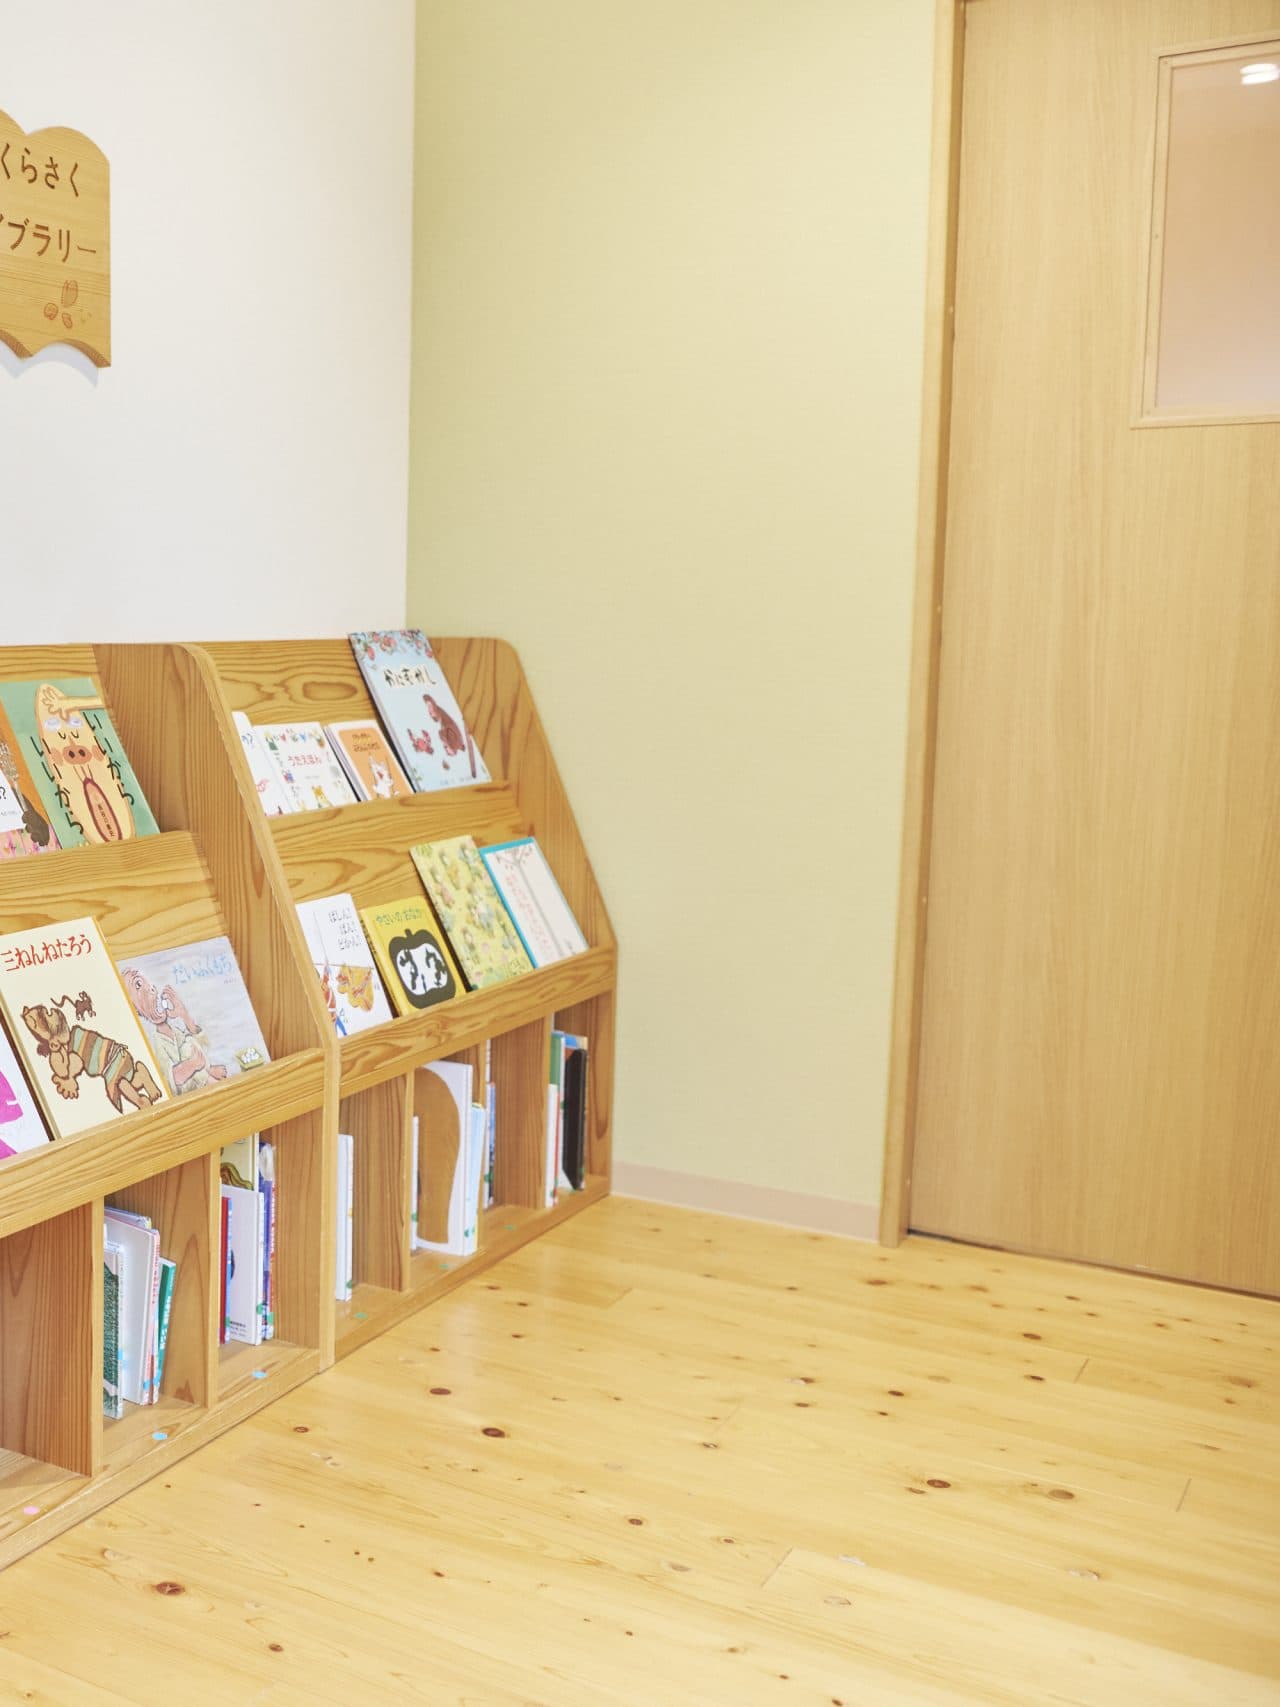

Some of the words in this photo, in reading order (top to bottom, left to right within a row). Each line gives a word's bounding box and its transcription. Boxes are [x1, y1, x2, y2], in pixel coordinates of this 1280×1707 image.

[0, 934, 92, 972] 三ねんねたろう
